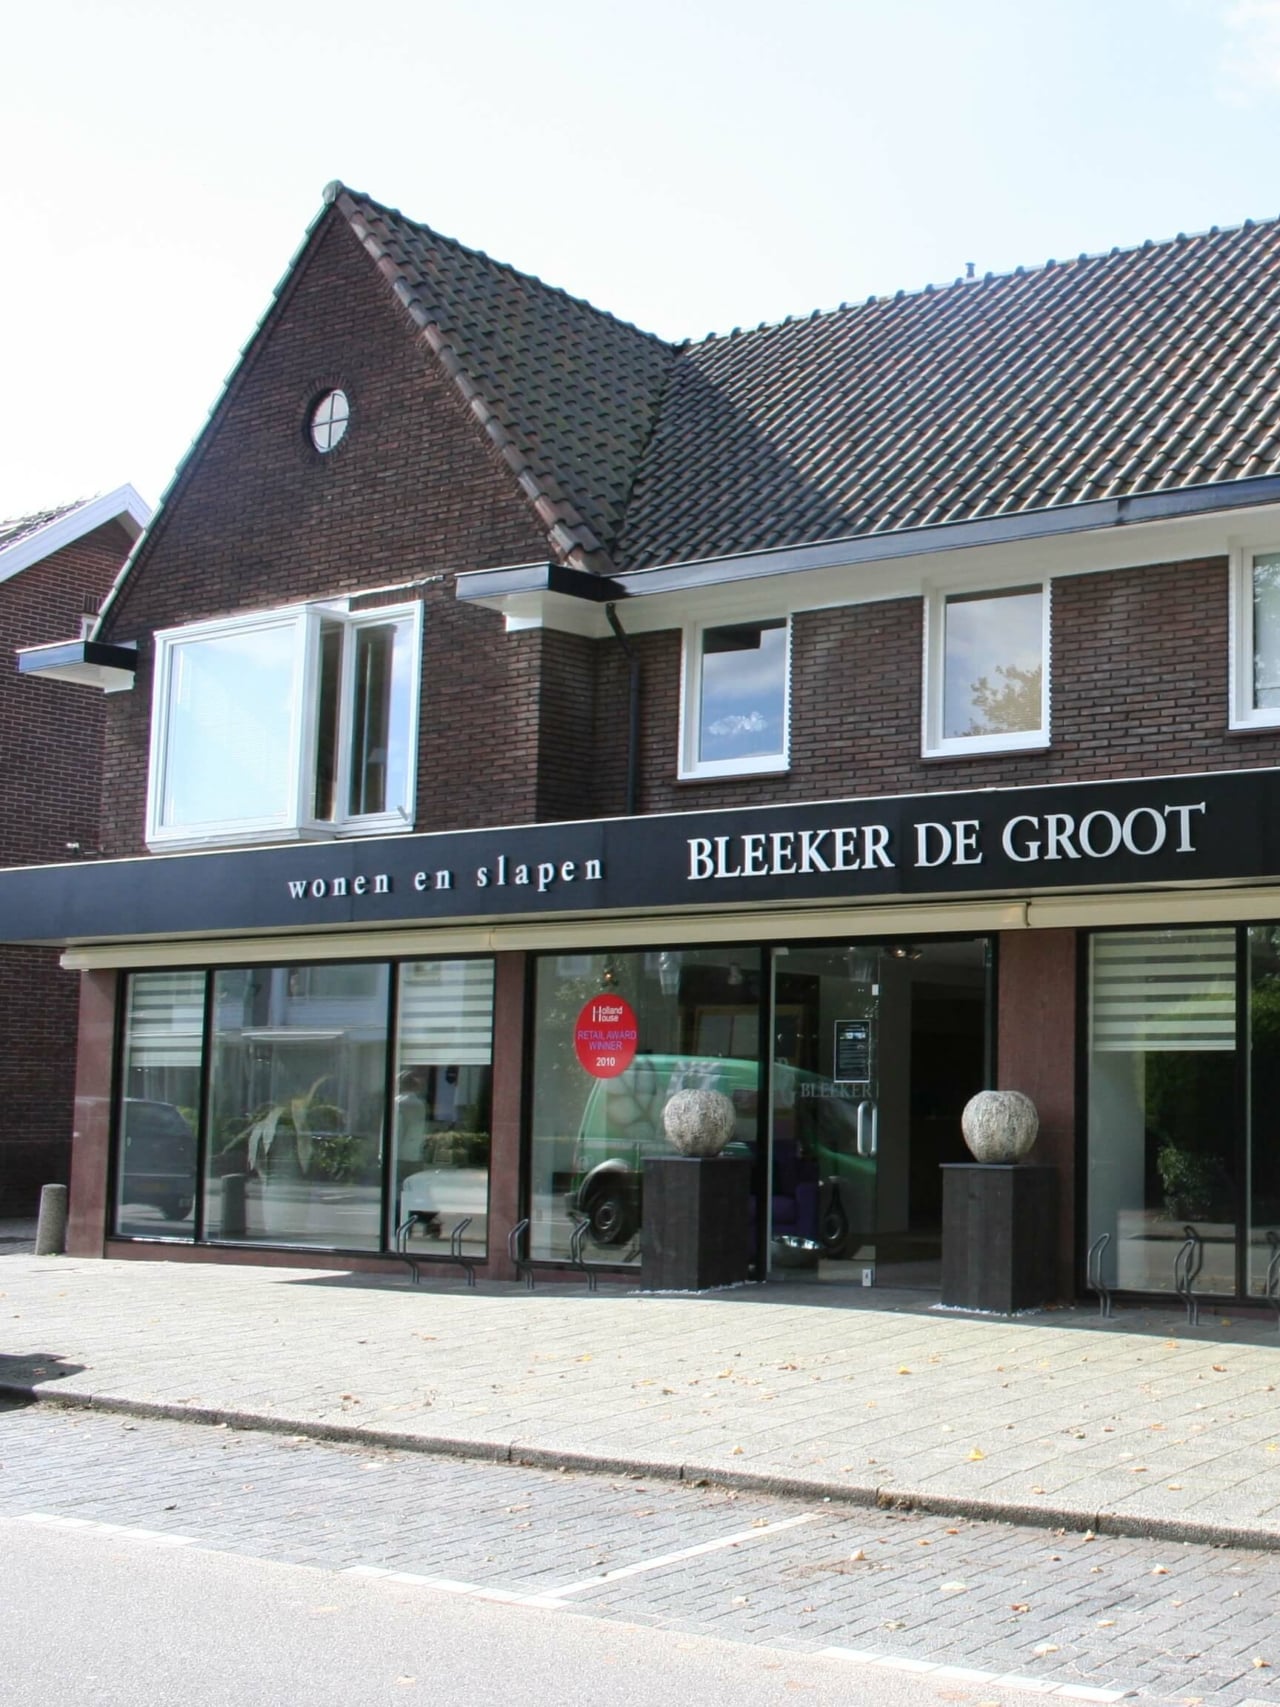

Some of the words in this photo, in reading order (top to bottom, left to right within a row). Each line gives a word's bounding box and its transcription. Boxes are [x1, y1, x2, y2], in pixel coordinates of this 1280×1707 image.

[687, 825, 896, 880] BLEEKER
[914, 819, 983, 867] DE
[1002, 801, 1206, 862] GROOT
[287, 873, 391, 900] wonen
[414, 869, 454, 891] en
[476, 855, 605, 894] slapen
[592, 1006, 623, 1022] Holland
[577, 1030, 604, 1040] RETAIL
[606, 1030, 637, 1040] AWARD
[589, 1041, 623, 1050] WINNER
[596, 1057, 616, 1067] 2010
[800, 1082, 872, 1098] BLEEKER
